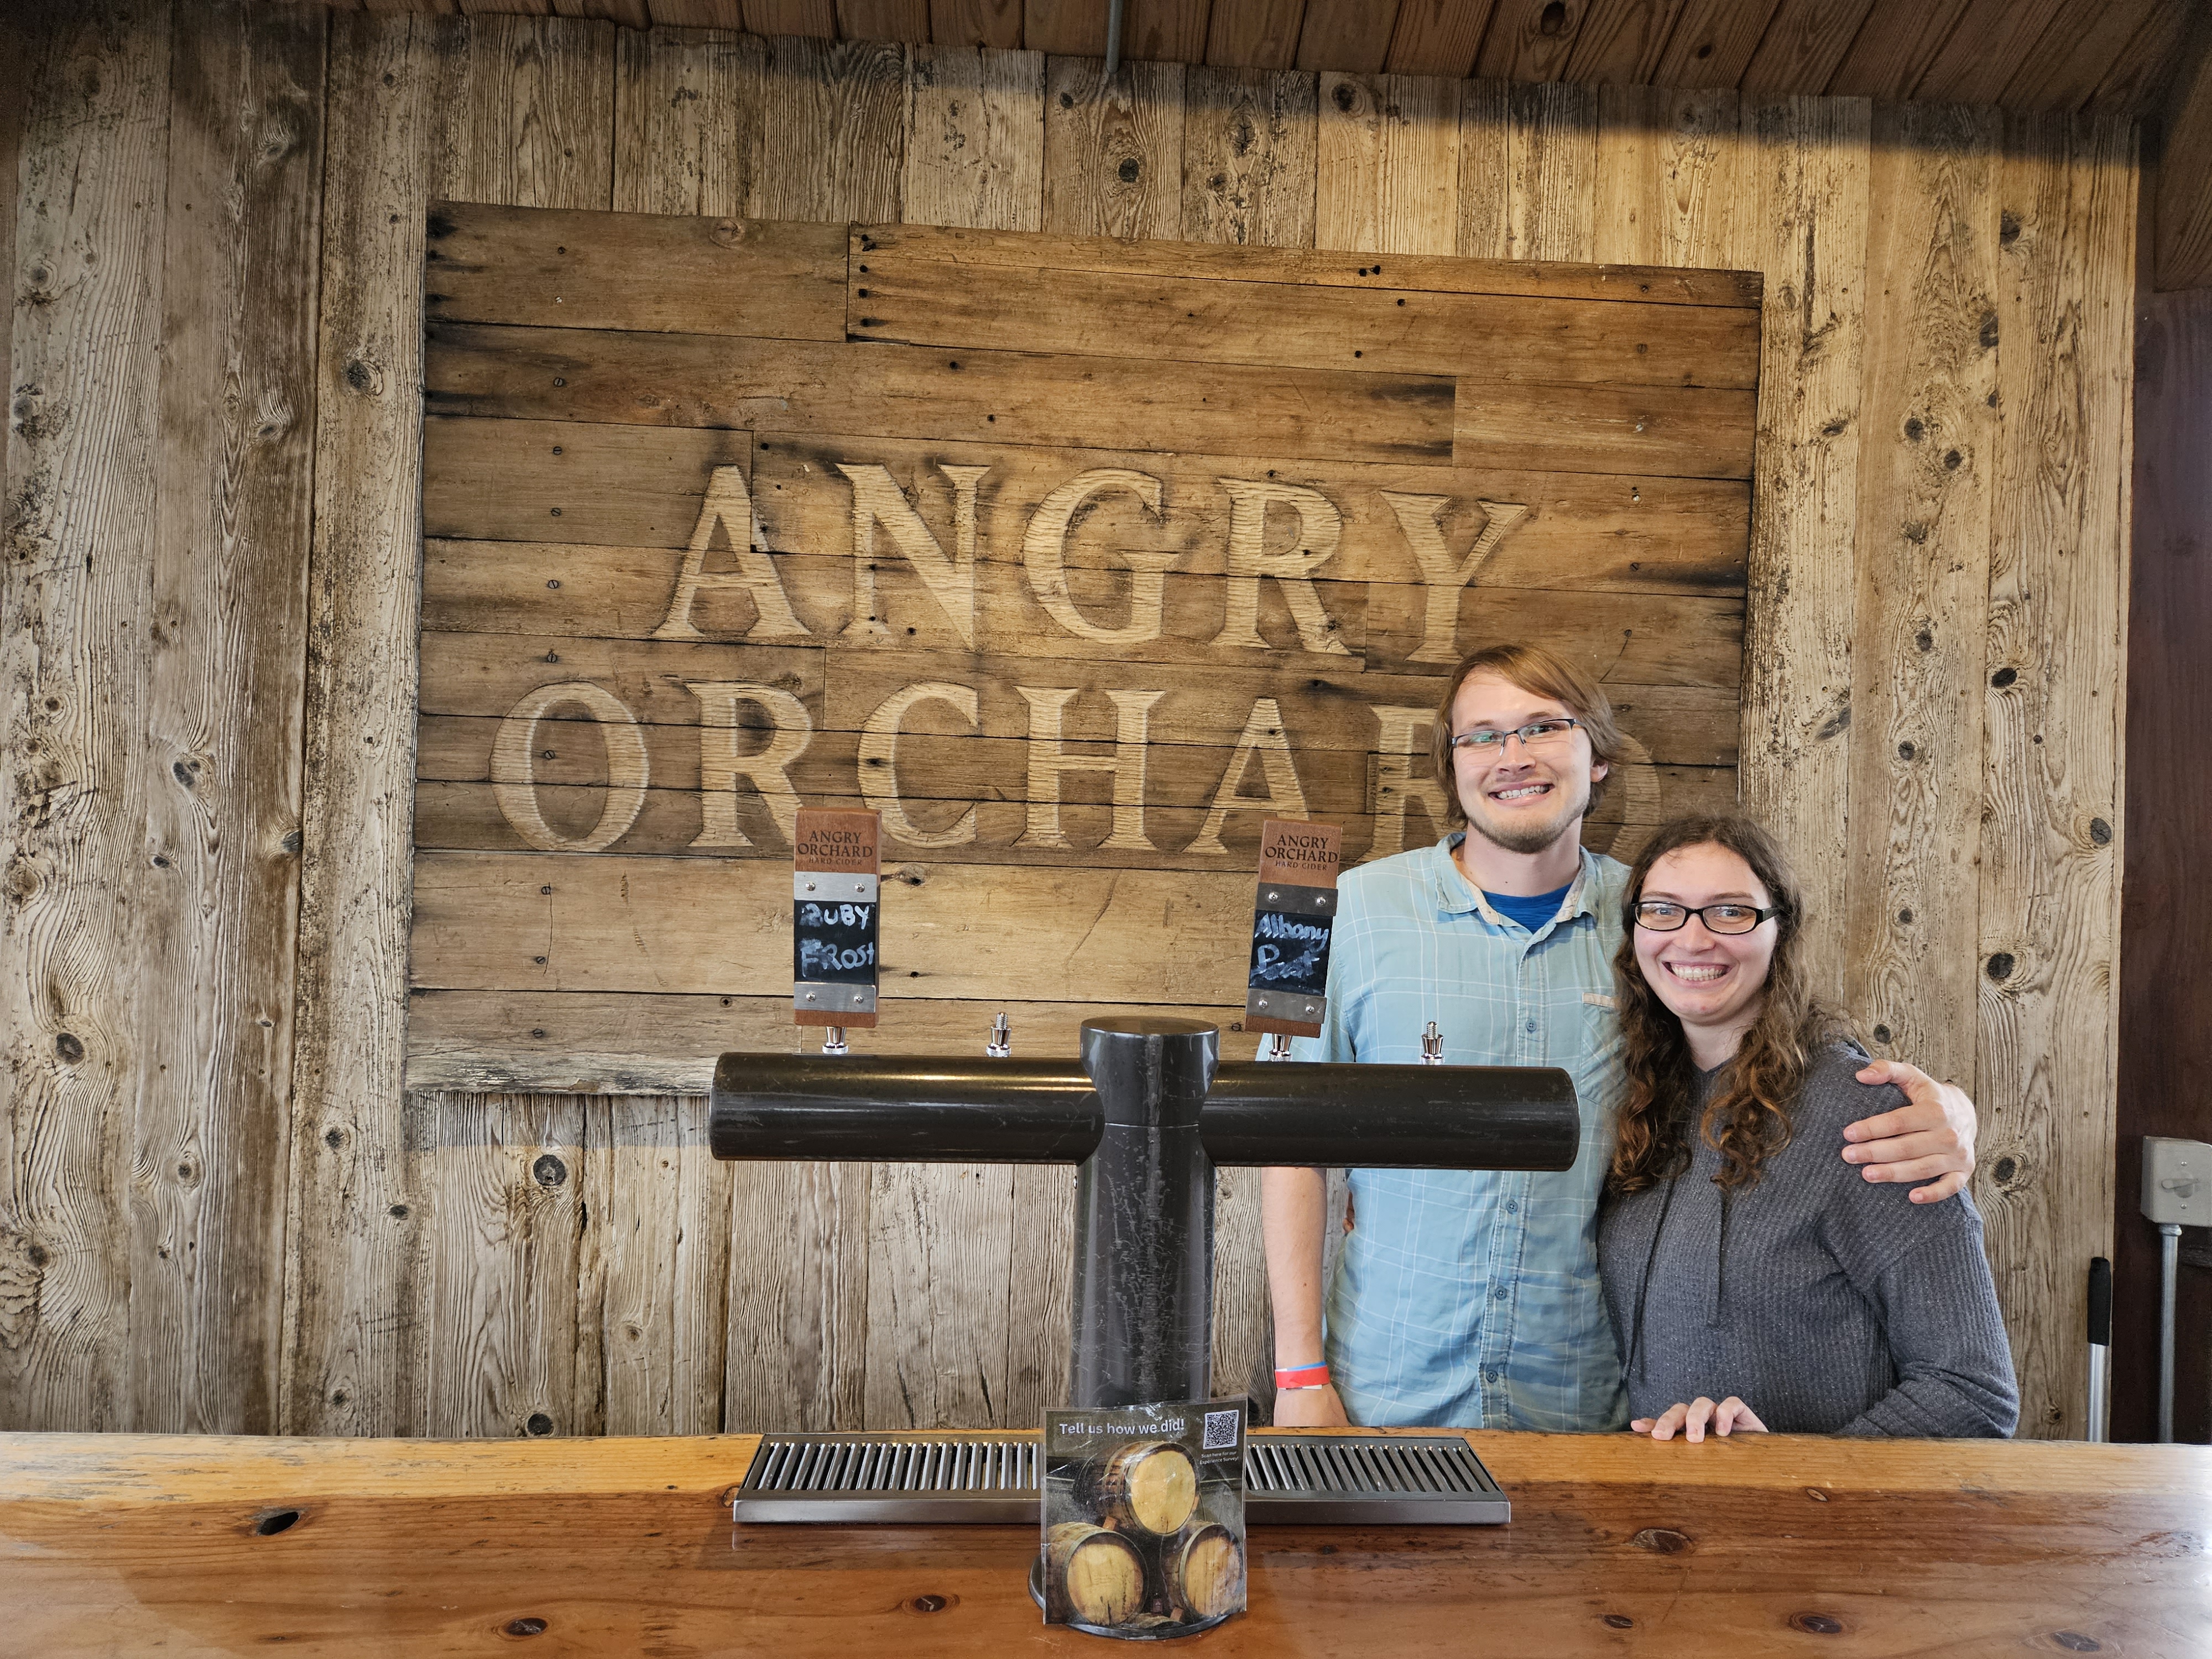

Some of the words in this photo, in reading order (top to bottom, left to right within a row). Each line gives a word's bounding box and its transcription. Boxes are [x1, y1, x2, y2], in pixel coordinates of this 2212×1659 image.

[651, 462, 1530, 664] ANGRY
[809, 830, 862, 843] ANGRY
[1277, 834, 1329, 849] ANGRY
[797, 843, 873, 857] ORCHARD
[1265, 846, 1338, 863] ORCHARD
[1254, 912, 1329, 953] Albany
[1254, 944, 1321, 980] Pt
[1059, 1422, 1084, 1434] Tell
[1088, 1425, 1103, 1434] us
[1107, 1423, 1135, 1434] how
[1138, 1423, 1157, 1434] we
[1161, 1418, 1185, 1432] did!
